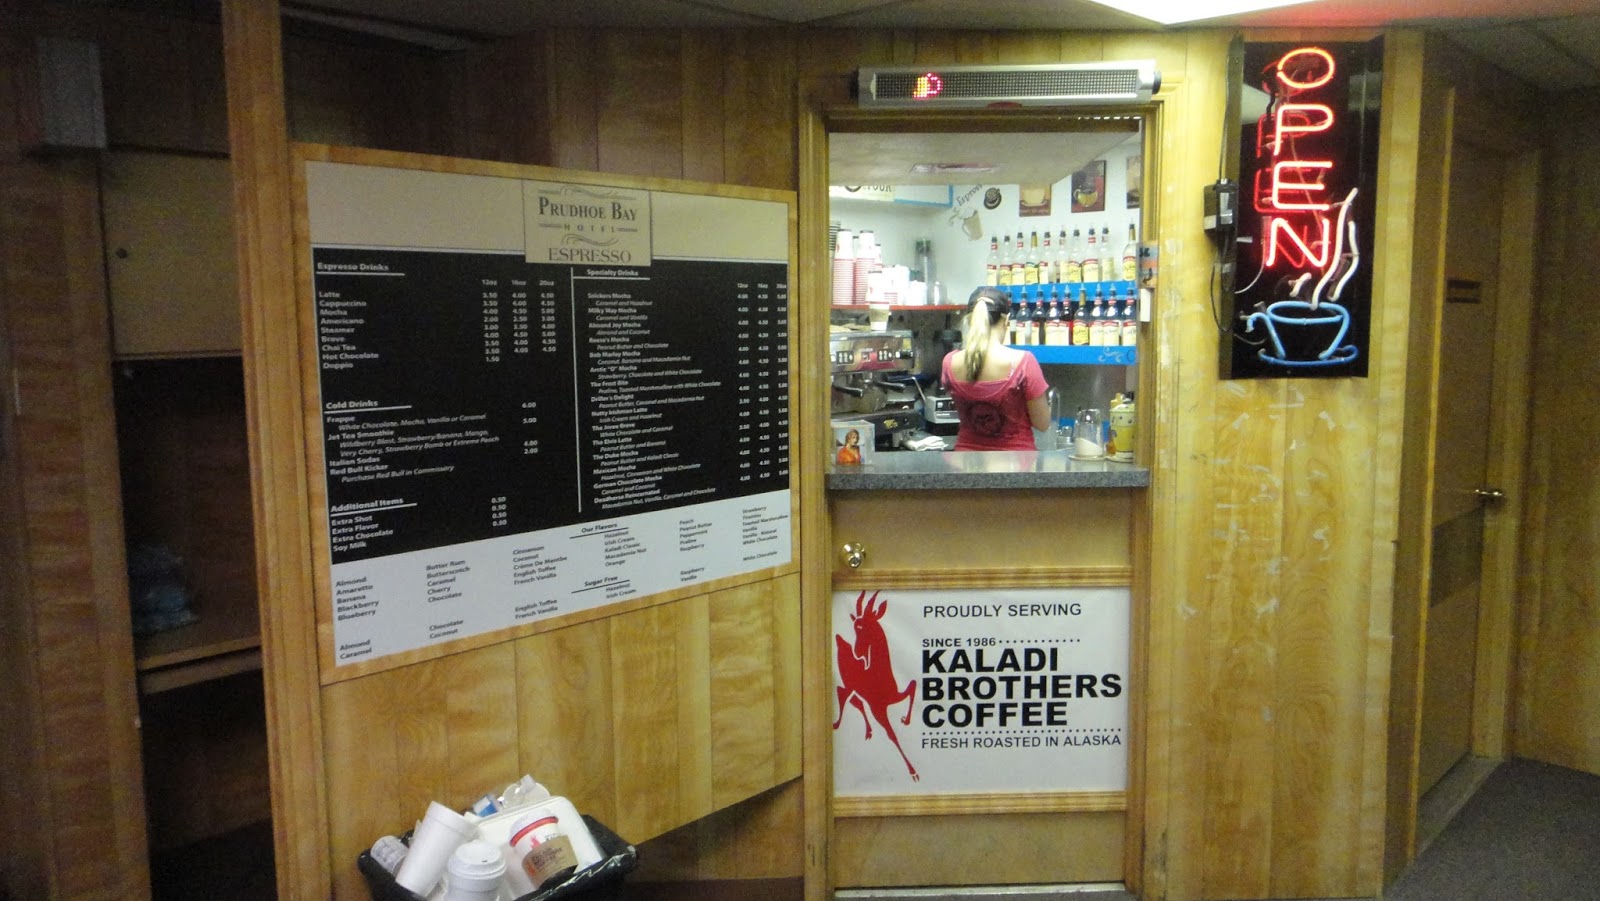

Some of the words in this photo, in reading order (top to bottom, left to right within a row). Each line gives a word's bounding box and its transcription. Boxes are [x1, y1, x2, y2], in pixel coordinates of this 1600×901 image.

[1265, 47, 1335, 267] OPEN
[538, 196, 606, 219] PRUDHOE
[611, 202, 637, 220] BAY
[564, 223, 615, 233] HOTEL
[548, 247, 631, 263] ESPRESSO
[317, 262, 358, 271] Espresso
[359, 263, 389, 271] Drinks
[586, 268, 617, 276] Specialty
[325, 401, 347, 409] Cold
[348, 399, 378, 408] Drinks
[330, 499, 378, 512] Additional
[379, 498, 403, 506] Items
[584, 579, 603, 587] Sugar
[923, 605, 1002, 618] PROUDLY
[1008, 603, 1082, 616] SERVING
[922, 638, 961, 647] SINCE
[966, 637, 996, 647] 1986
[922, 647, 1058, 673] KALADI
[922, 674, 1122, 701] BROTHERS
[922, 702, 1067, 728] COFFEE
[921, 737, 968, 749] FRESH
[973, 736, 1040, 748] ROASTED
[1045, 736, 1058, 747] IN
[1063, 735, 1121, 747] ALASKA
